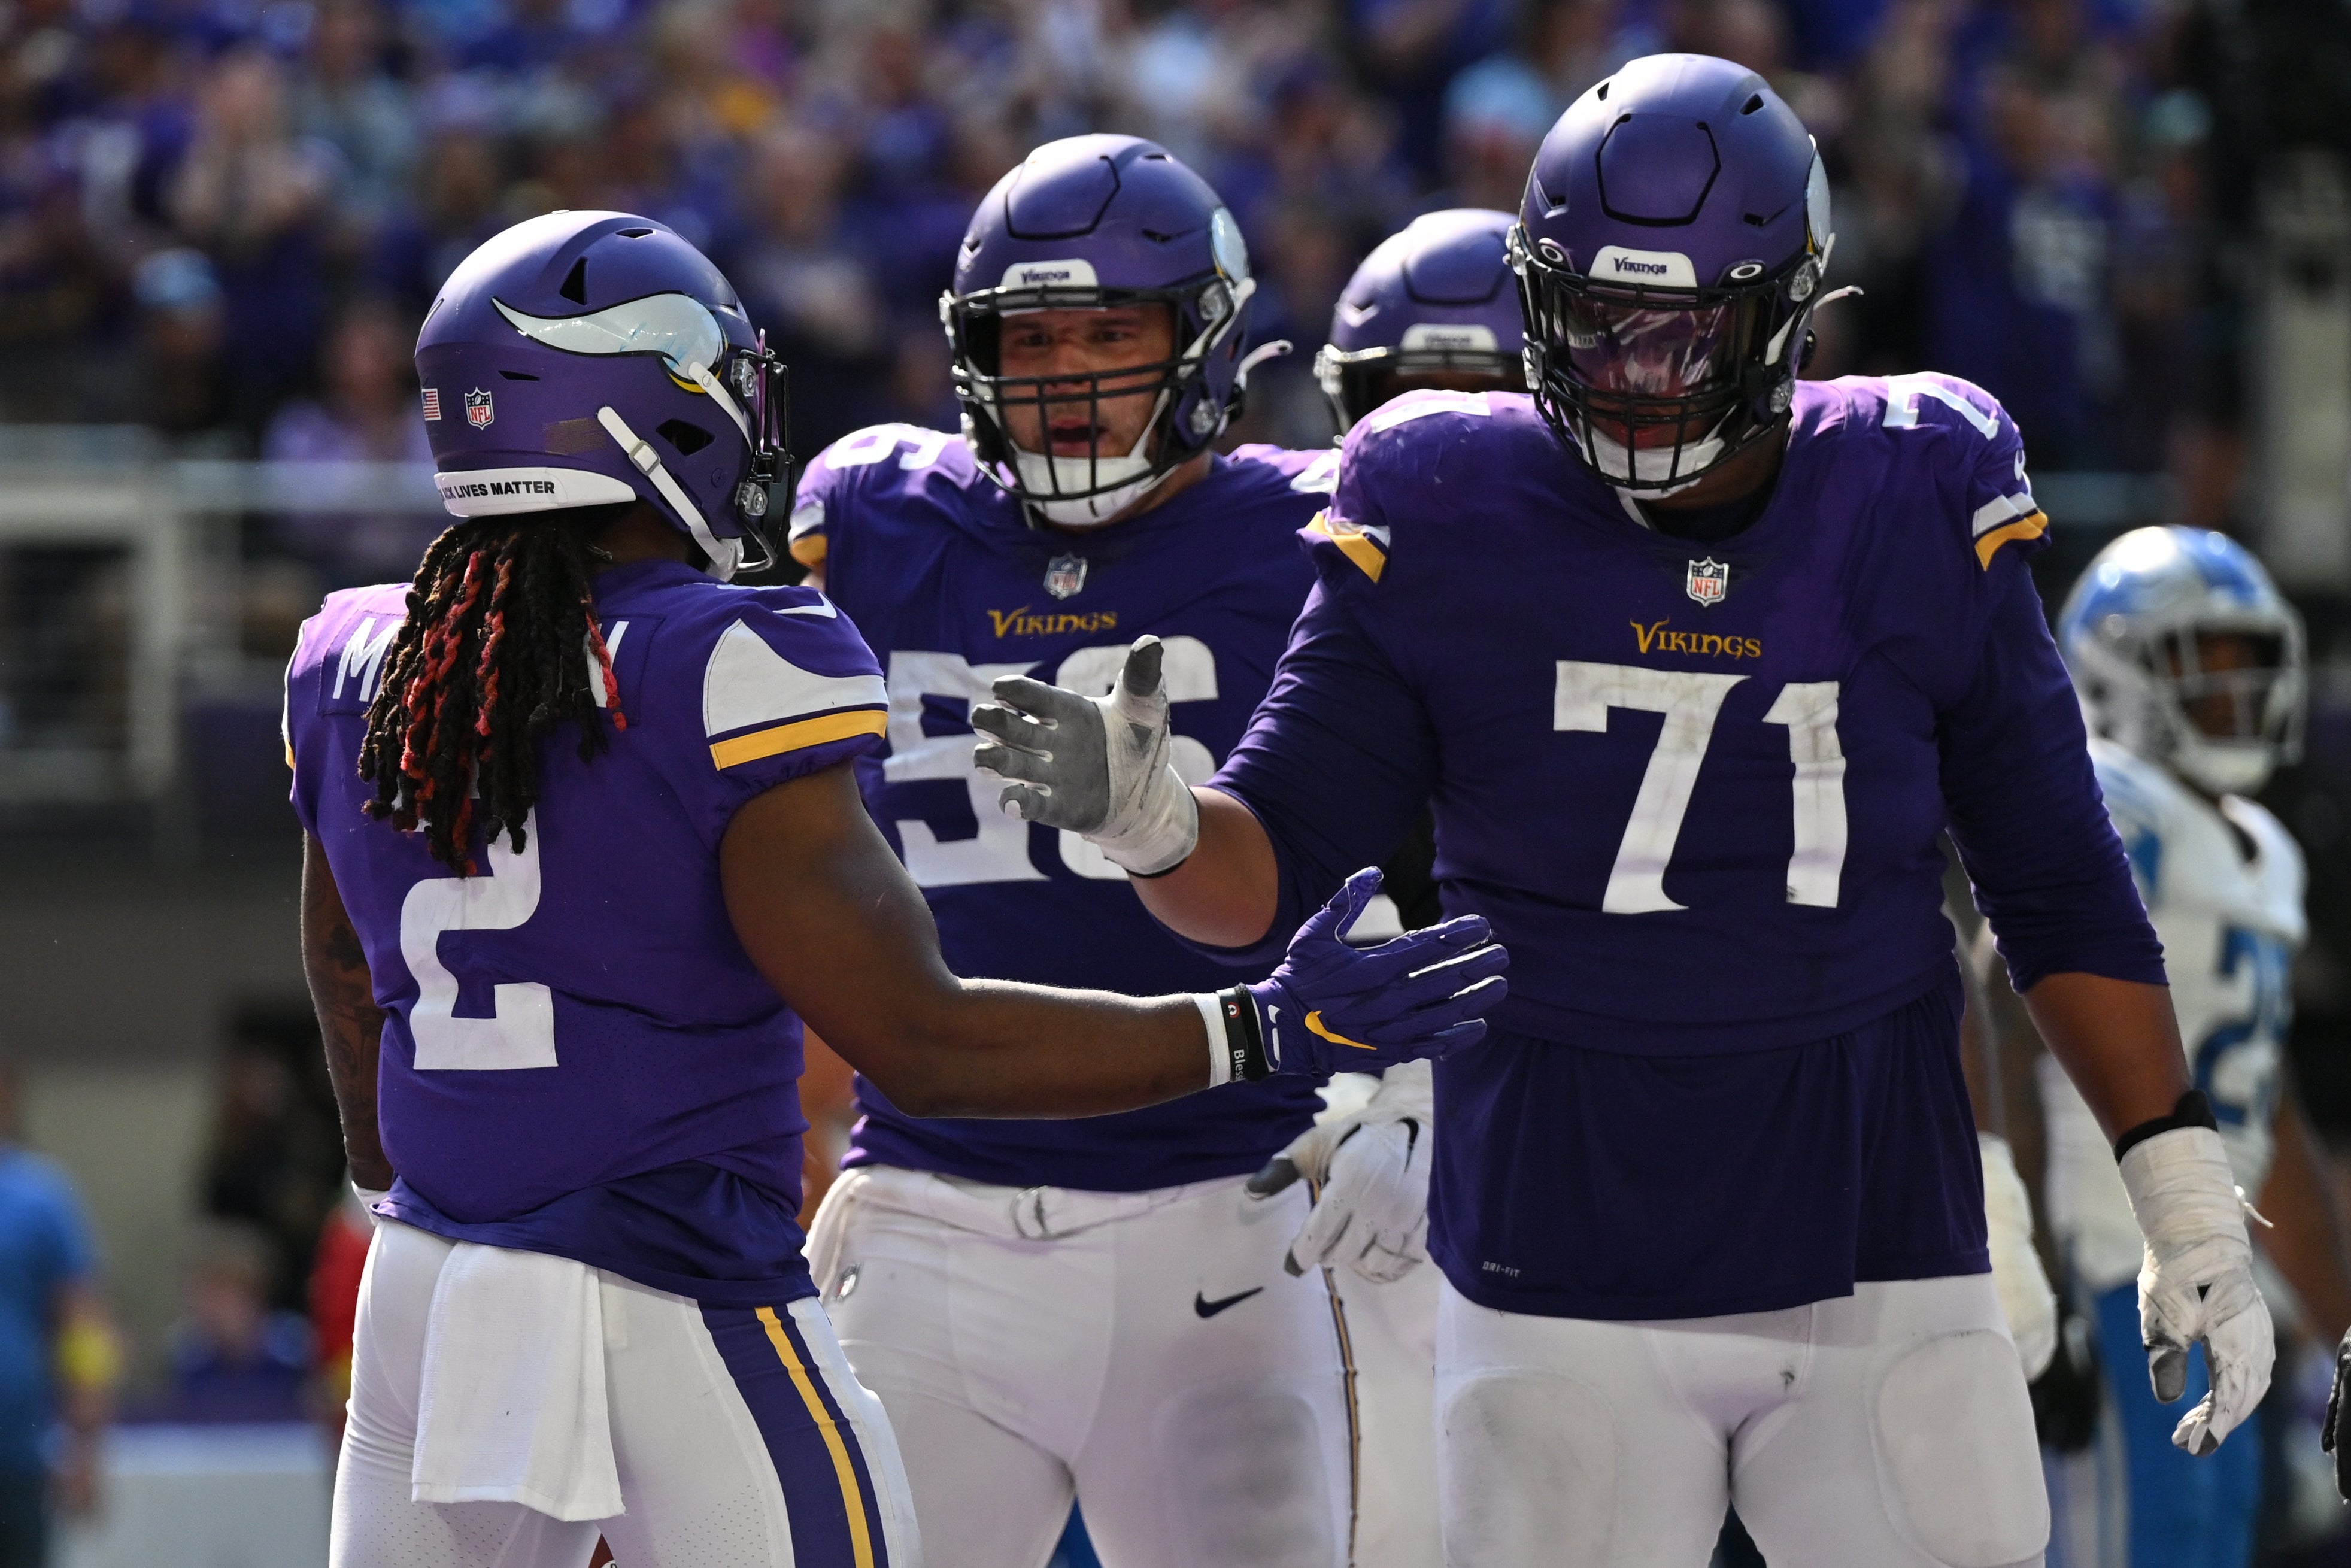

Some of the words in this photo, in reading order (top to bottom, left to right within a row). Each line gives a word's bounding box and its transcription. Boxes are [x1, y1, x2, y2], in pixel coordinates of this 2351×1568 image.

[469, 407, 490, 423] NFL
[454, 484, 488, 498] LIVES
[490, 481, 555, 495] MATTER
[1693, 578, 1721, 597] NFL
[1553, 659, 1848, 915] 71
[399, 763, 559, 1070] 2
[1482, 1260, 1521, 1278] DRI-FIT
